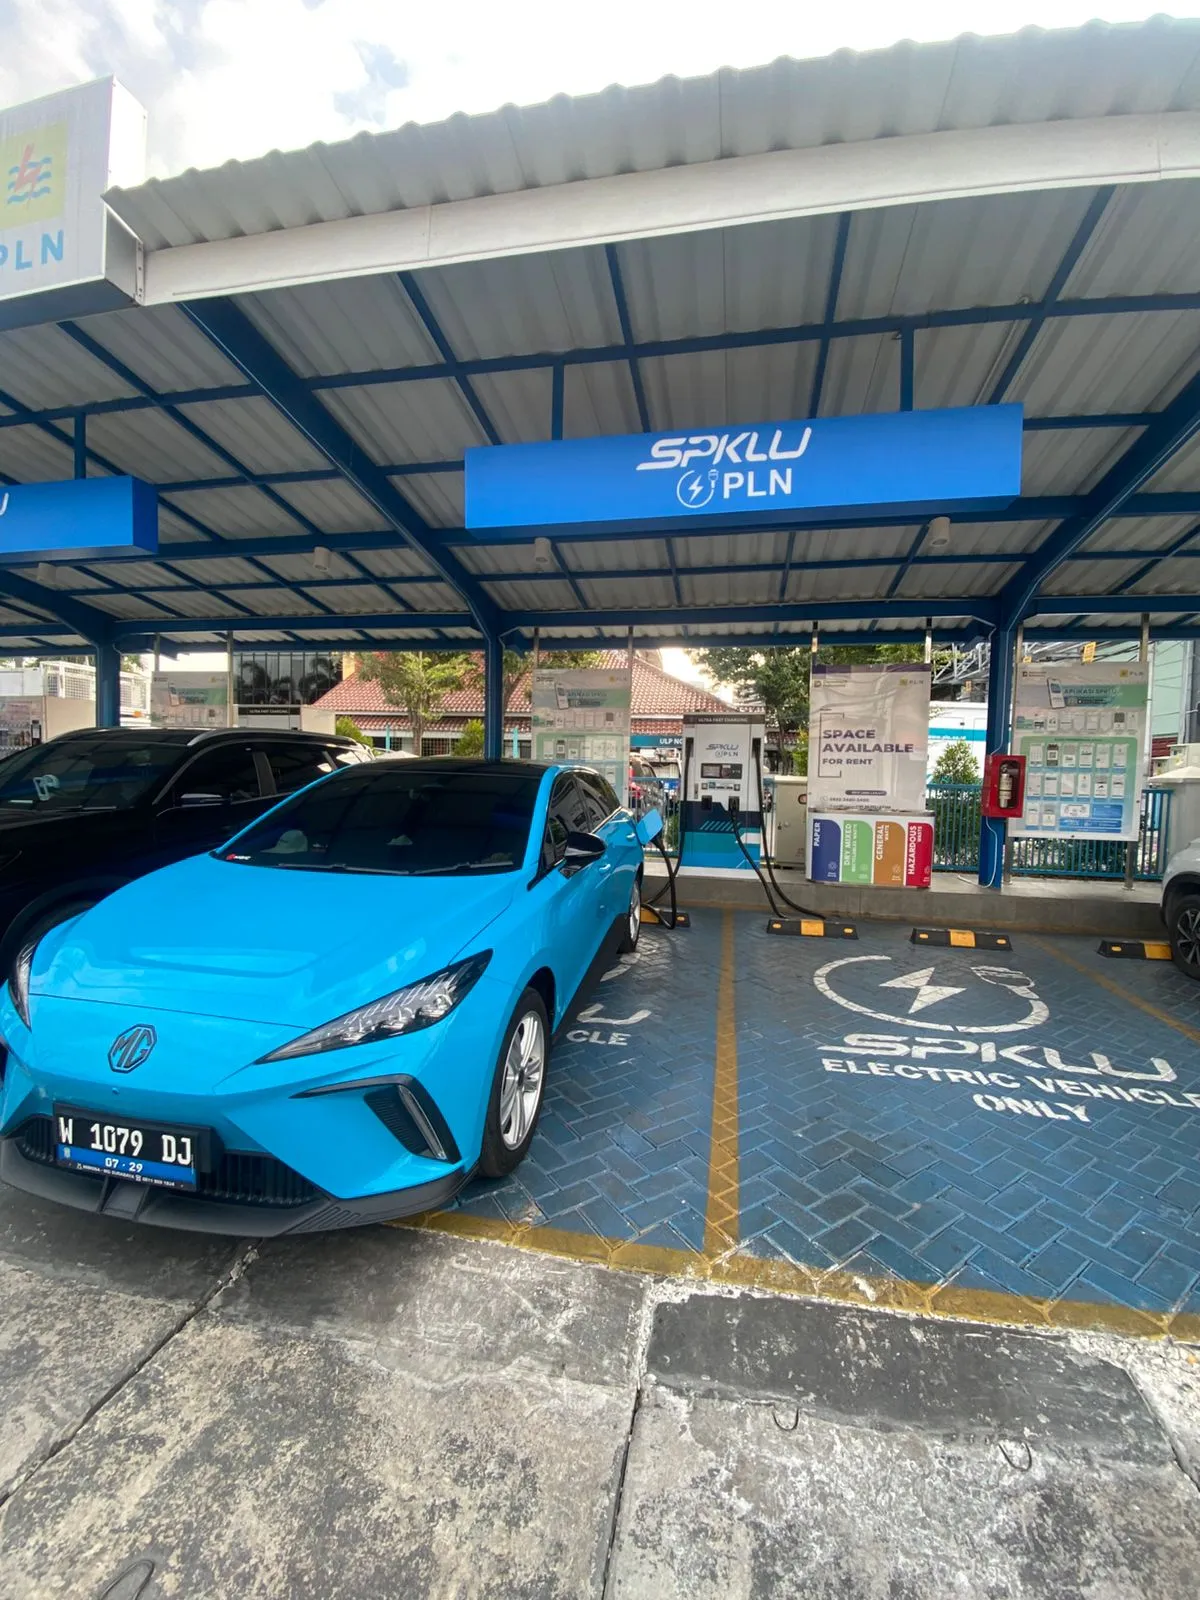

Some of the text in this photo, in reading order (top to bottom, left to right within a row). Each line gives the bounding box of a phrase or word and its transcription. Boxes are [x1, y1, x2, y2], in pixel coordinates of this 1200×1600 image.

[636, 427, 812, 471] SPKLU
[723, 468, 793, 499] PLN
[822, 744, 914, 753] AVAILABLE
[823, 730, 876, 739] SPACE
[876, 824, 884, 860] GENERAL
[907, 825, 917, 875] HAZARDOUS
[110, 1026, 155, 1071] MG
[817, 1033, 1177, 1082] SPKLU
[821, 1058, 1021, 1089] ELECTRIC
[972, 1093, 1091, 1122] ONLY
[59, 1117, 192, 1165] W 1079 DJ
[105, 1157, 119, 1169] 07
[129, 1161, 143, 1173] 29
